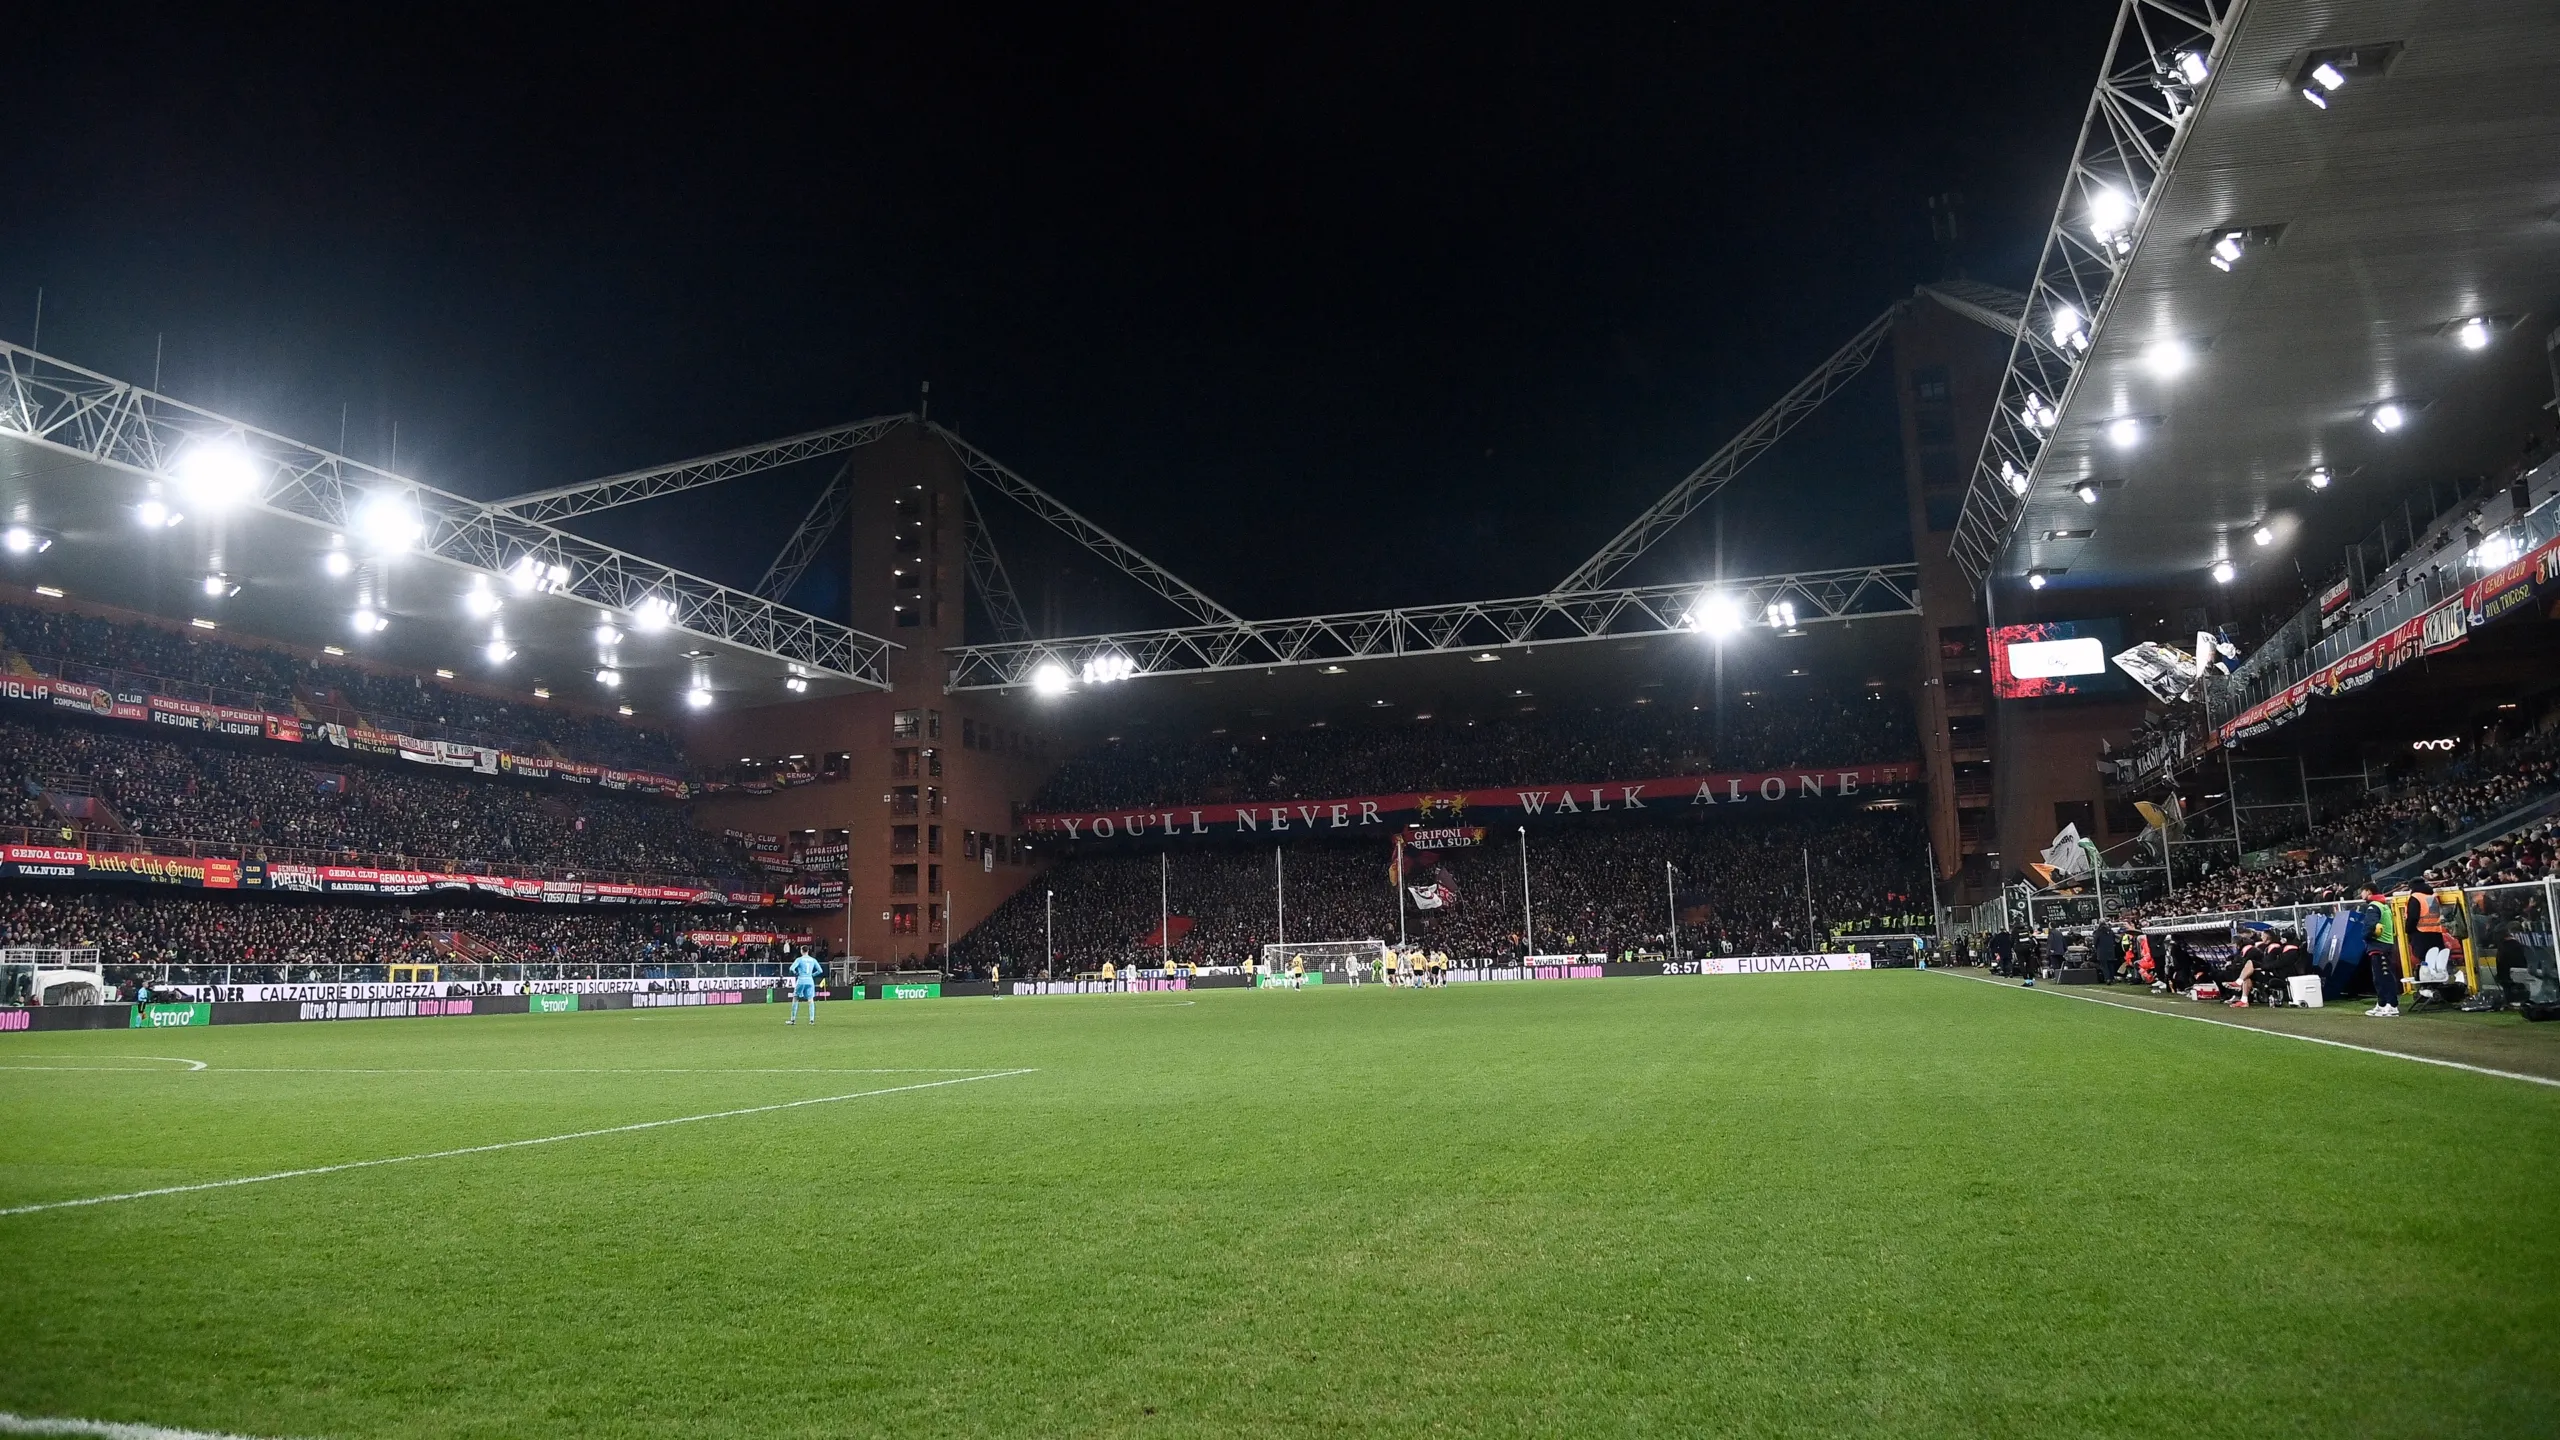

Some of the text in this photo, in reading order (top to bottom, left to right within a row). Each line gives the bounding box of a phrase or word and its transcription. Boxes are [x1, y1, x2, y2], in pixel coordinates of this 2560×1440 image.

[2485, 560, 2527, 594] GENOA CLUB
[2485, 600, 2501, 618] RIVA
[2392, 619, 2419, 649] VALLE
[0, 681, 48, 700] IGLIA
[56, 682, 142, 705] GENOA CLUB
[53, 697, 141, 717] COMPAGNIA UNICA
[153, 698, 179, 710] GENOA
[180, 703, 201, 713] CLUB
[221, 709, 263, 721] DIPENDENTI
[154, 711, 259, 736] REGIONE LIGURIA
[300, 722, 312, 731] CLUB
[353, 729, 398, 741] GENOA CLUB
[356, 736, 387, 747] TIGLIETO
[353, 742, 370, 752] REAL
[400, 735, 419, 750] GENOA
[420, 740, 434, 752] CLUB
[446, 743, 459, 755] NEW
[511, 755, 553, 768] GENOA CLUB
[555, 761, 598, 774] GENOA CLUB
[518, 767, 549, 778] BUSALLA
[561, 773, 591, 784] COGOLETO
[607, 770, 628, 781] ACQUI
[1060, 772, 1861, 840] YOU'LL NEVER WALK ALONE
[758, 835, 777, 843] CLUB
[1413, 828, 1462, 841] GRIFONI
[1446, 837, 1471, 847] SUD
[12, 849, 51, 859] GENOA
[53, 851, 83, 861] CLUB
[805, 844, 848, 855] GENOA CLUB
[87, 853, 205, 880] Little Club Genoa
[805, 856, 835, 864] RAPALLO
[18, 865, 75, 876] VALNURE
[277, 865, 317, 875] GENOA CLUB
[328, 869, 379, 879] GENOA CLUB
[270, 871, 324, 892] PORTUALI
[379, 873, 407, 884] GENOA
[409, 875, 428, 884] CLUB
[331, 882, 377, 892] SARDEGNA
[379, 885, 406, 893] CROCE
[691, 933, 730, 942] GENOA CLUB
[742, 934, 767, 943] GRIFONI
[1662, 961, 1700, 975] 26:57
[1739, 956, 1830, 973] FIUMARA
[1480, 967, 1490, 981] di
[1491, 967, 1522, 981] utenti
[1522, 965, 1533, 980] in
[1535, 965, 1559, 980] tutto
[1561, 965, 1568, 979] il
[1569, 964, 1603, 979] mondo
[577, 981, 586, 994] DI
[588, 981, 640, 993] SICUREZZA
[698, 979, 743, 991] CALZATURE
[744, 979, 752, 988] DI
[1013, 981, 1035, 996] Oltre
[1036, 981, 1047, 995] 30
[1048, 980, 1077, 994] milioni
[1078, 980, 1087, 993] di
[1116, 978, 1125, 992] in
[1150, 977, 1156, 991] il
[260, 984, 347, 1001] CALZATURE
[351, 985, 365, 999] DI
[300, 998, 473, 1020] Oltre 30 milioni di utenti in tutto il mondo
